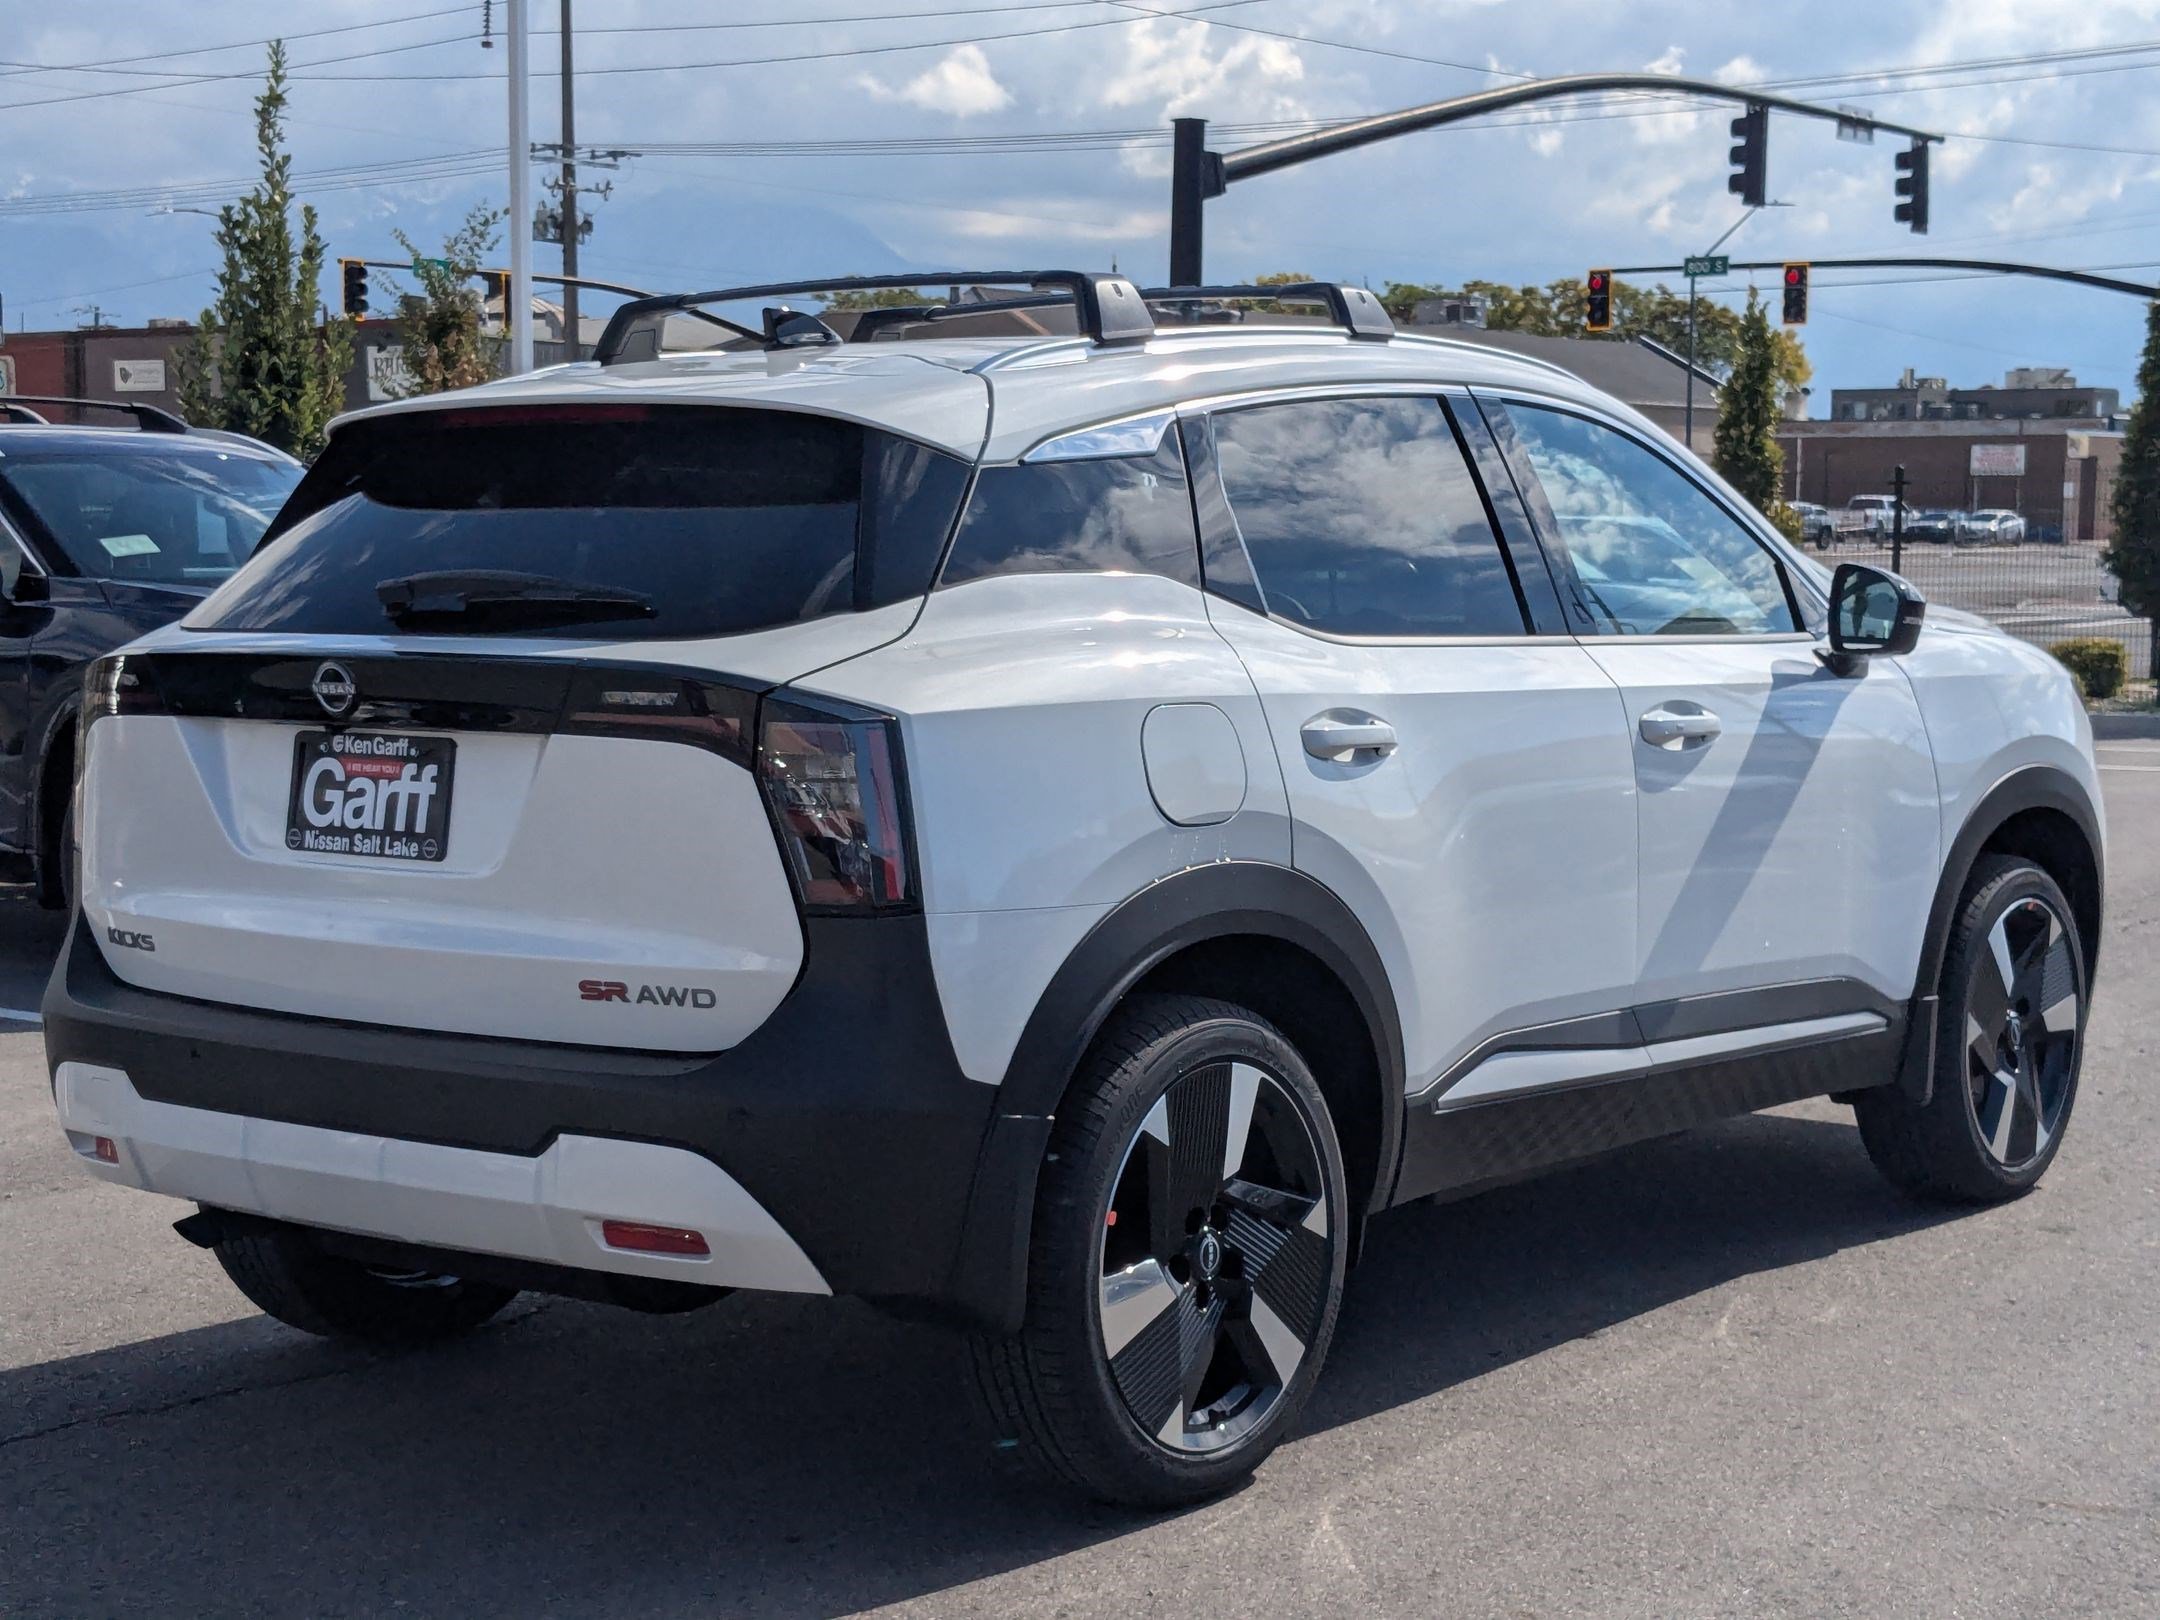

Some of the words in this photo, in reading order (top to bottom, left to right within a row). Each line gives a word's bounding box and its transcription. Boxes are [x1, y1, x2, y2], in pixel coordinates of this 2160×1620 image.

[1715, 260, 1723, 272] S
[312, 682, 356, 695] NISSAN
[345, 735, 372, 755] Ken
[373, 736, 409, 757] Garff
[303, 757, 438, 834] Garff
[304, 829, 350, 851] Nissan
[353, 833, 381, 855] Salt
[384, 836, 419, 857] Lake
[578, 979, 632, 1003] SR
[636, 984, 717, 1009] AWD
